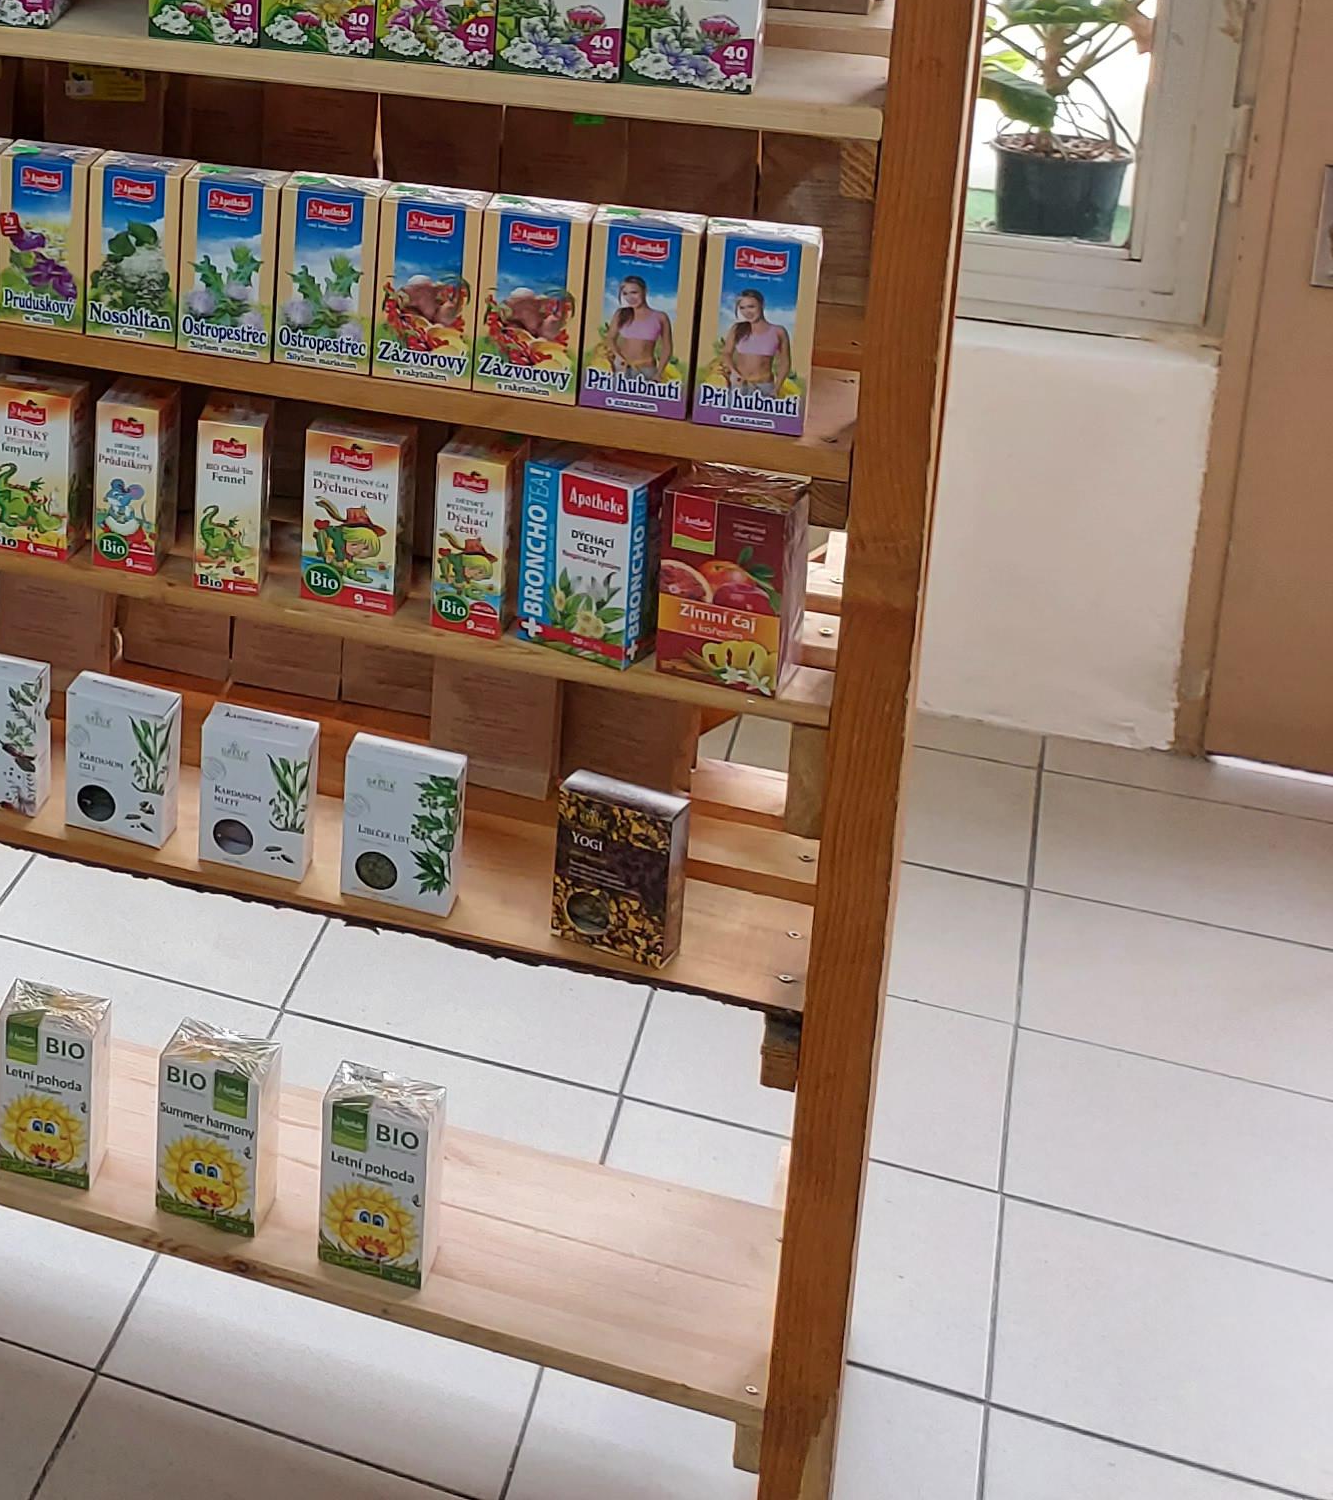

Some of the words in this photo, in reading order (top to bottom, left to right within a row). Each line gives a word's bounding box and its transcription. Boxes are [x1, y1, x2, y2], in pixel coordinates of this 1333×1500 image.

[89, 304, 171, 331] Nosohltan
[182, 318, 267, 345] Ostropestřec
[377, 340, 468, 375] Zázvorový
[587, 368, 613, 391] Při
[616, 376, 679, 401] hubnutí
[212, 472, 246, 485] Fennel
[569, 488, 624, 514] Apotheke
[576, 543, 607, 557] CESTY
[310, 569, 338, 591] Bio
[680, 602, 728, 623] Zimní
[731, 613, 753, 635] čaj
[572, 831, 604, 854] YOGI
[46, 1039, 85, 1061] BIO
[5, 1065, 33, 1081] Letní
[37, 1072, 82, 1092] pohoda
[160, 1102, 204, 1123] Summer
[206, 1113, 255, 1139] harmony
[376, 1124, 419, 1149] BIO
[331, 1150, 361, 1169] Letní
[364, 1162, 415, 1183] pohoda
